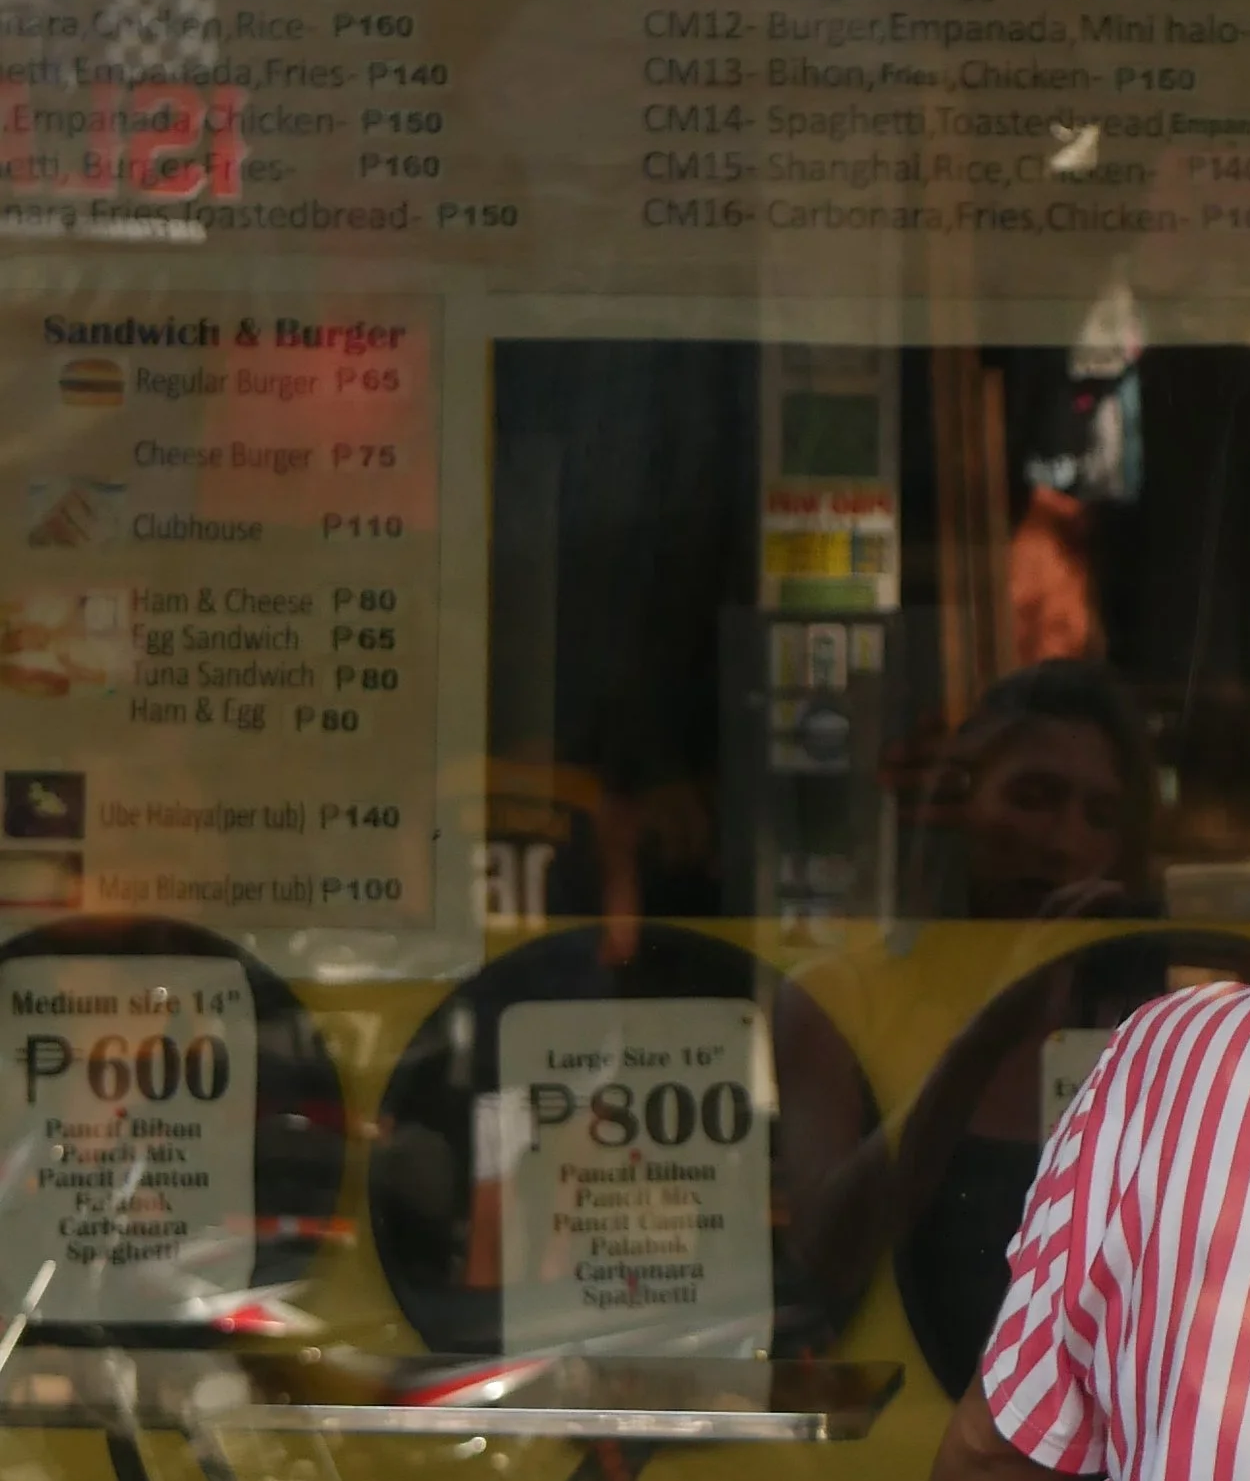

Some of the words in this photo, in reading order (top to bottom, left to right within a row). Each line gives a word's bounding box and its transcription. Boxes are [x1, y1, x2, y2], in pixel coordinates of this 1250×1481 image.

[644, 10, 757, 39] CM12-
[644, 58, 758, 88] CM13-
[643, 104, 757, 135] CM14-
[642, 151, 758, 182] CM15-
[642, 198, 756, 230] CM16-
[43, 314, 220, 347] Sandwich
[233, 318, 262, 347] &
[274, 318, 407, 355] Burger
[136, 367, 227, 399] Regular
[237, 369, 317, 399] Burger
[133, 440, 222, 468] Cheese
[231, 442, 314, 475] Burger
[133, 513, 263, 542] Clubhouse
[131, 589, 188, 613] Ham
[199, 589, 218, 614] &
[224, 587, 314, 616] Cheese
[132, 626, 174, 657] Egg
[182, 625, 300, 651] Sandwich
[132, 662, 189, 688] Tuna
[196, 662, 315, 689] Sandwich
[130, 699, 187, 725] Ham
[195, 699, 216, 724] &
[222, 700, 267, 733] Egg
[261, 802, 306, 833] tub)
[270, 876, 314, 908] tub)
[12, 990, 118, 1016] Medium
[623, 1046, 671, 1069] Size
[131, 1119, 202, 1140] Bihon
[148, 1143, 187, 1164] Mix
